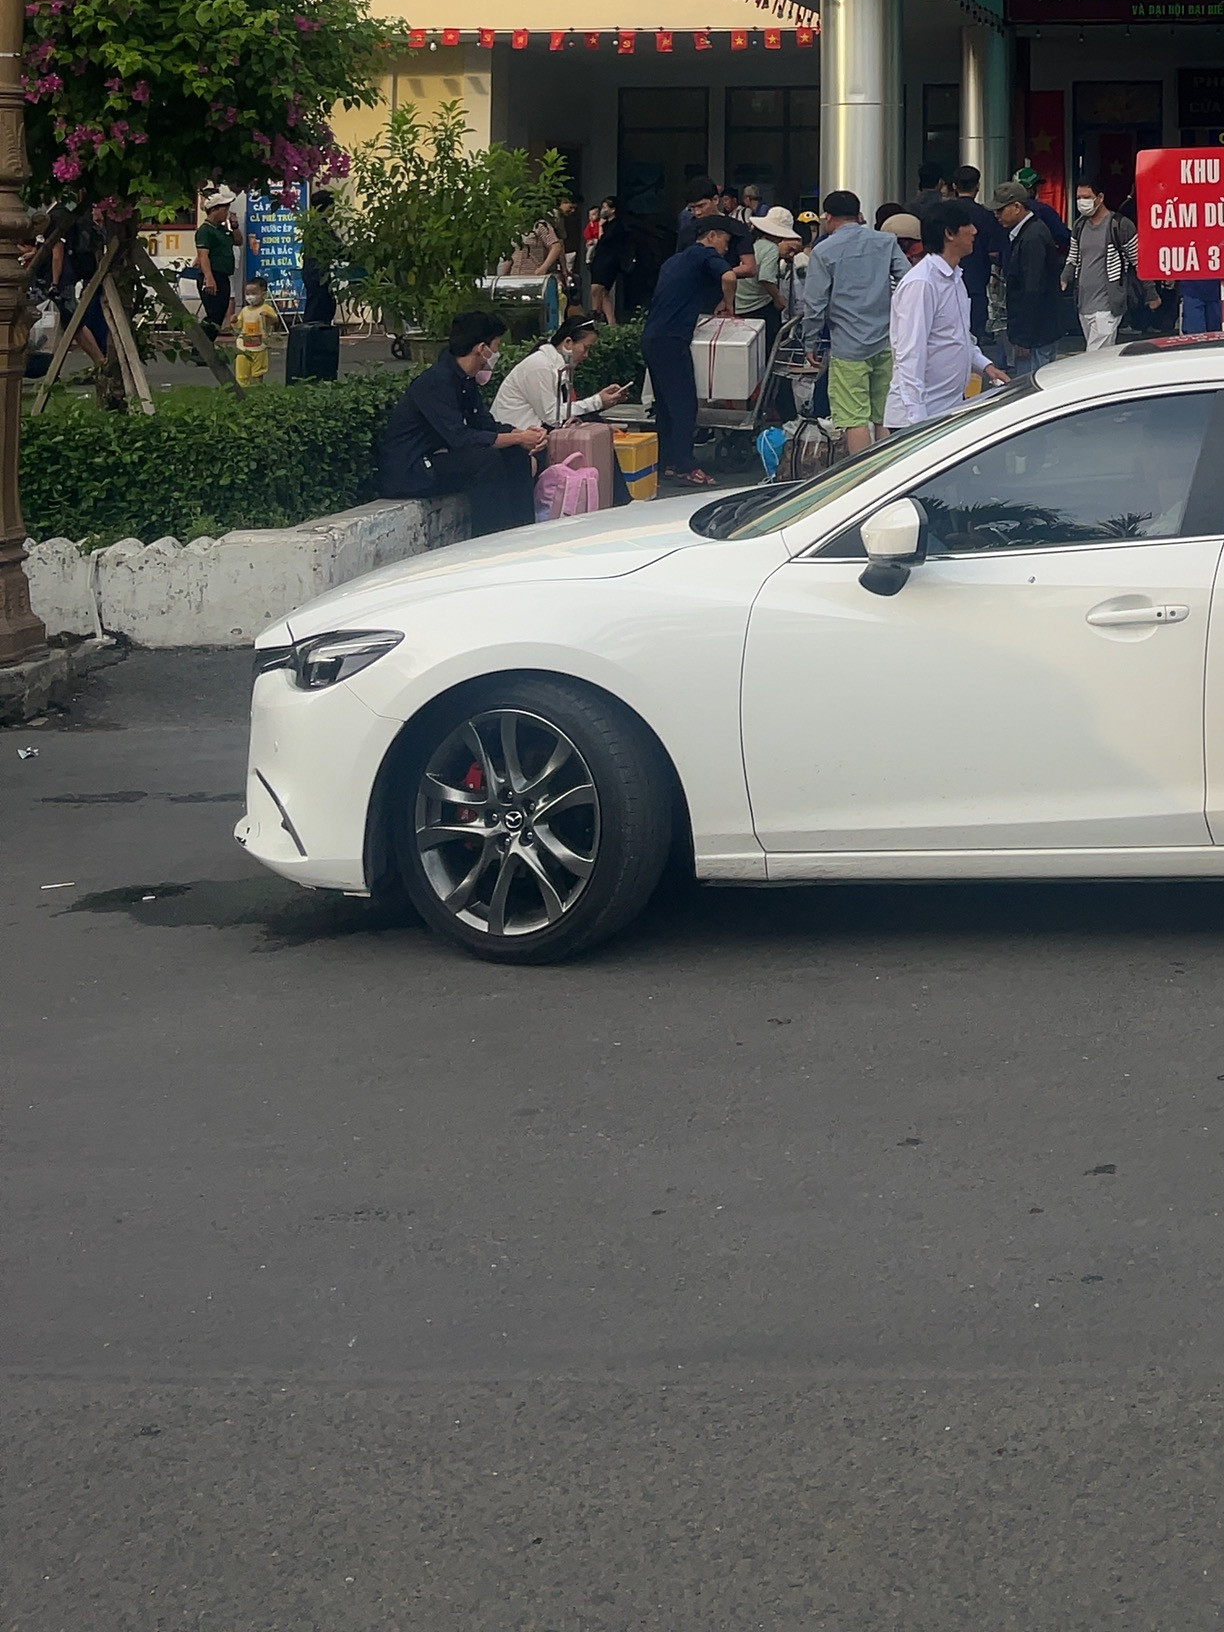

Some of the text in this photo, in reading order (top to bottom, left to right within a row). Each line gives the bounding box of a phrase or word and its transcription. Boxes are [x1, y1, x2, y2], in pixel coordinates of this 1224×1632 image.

[1180, 158, 1220, 184] KHU
[1150, 197, 1198, 229] CẤM
[1159, 241, 1200, 276] QUÁ
[1208, 245, 1220, 271] 3
